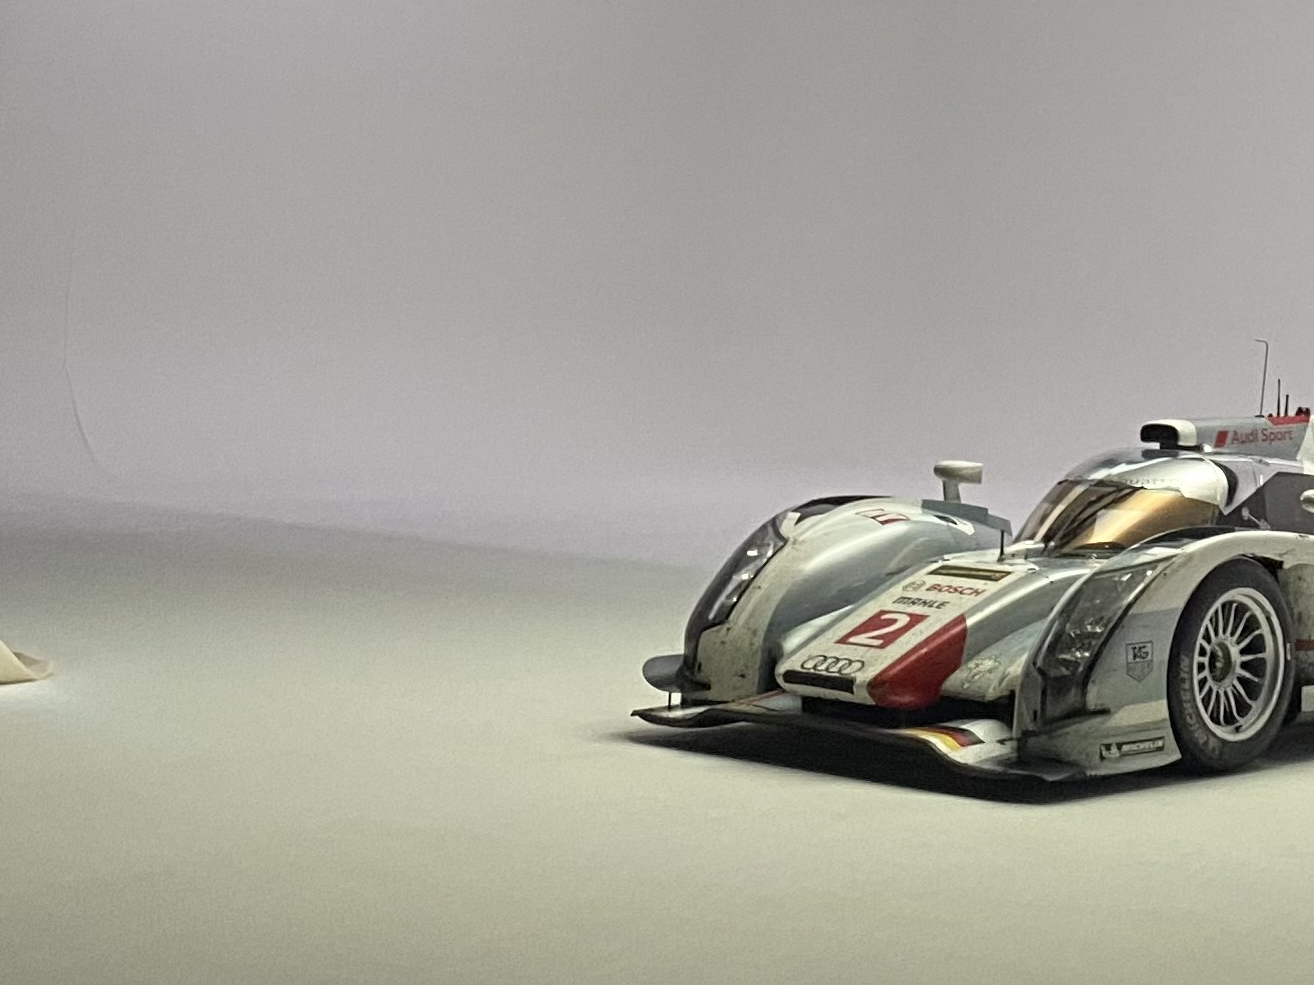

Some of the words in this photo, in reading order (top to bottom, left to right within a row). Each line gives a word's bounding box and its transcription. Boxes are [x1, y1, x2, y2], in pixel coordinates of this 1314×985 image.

[1231, 429, 1258, 445] Audi
[1262, 428, 1294, 446] Sport
[925, 583, 987, 597] BOSCH
[892, 595, 949, 610] MAHLE
[845, 612, 911, 647] 2
